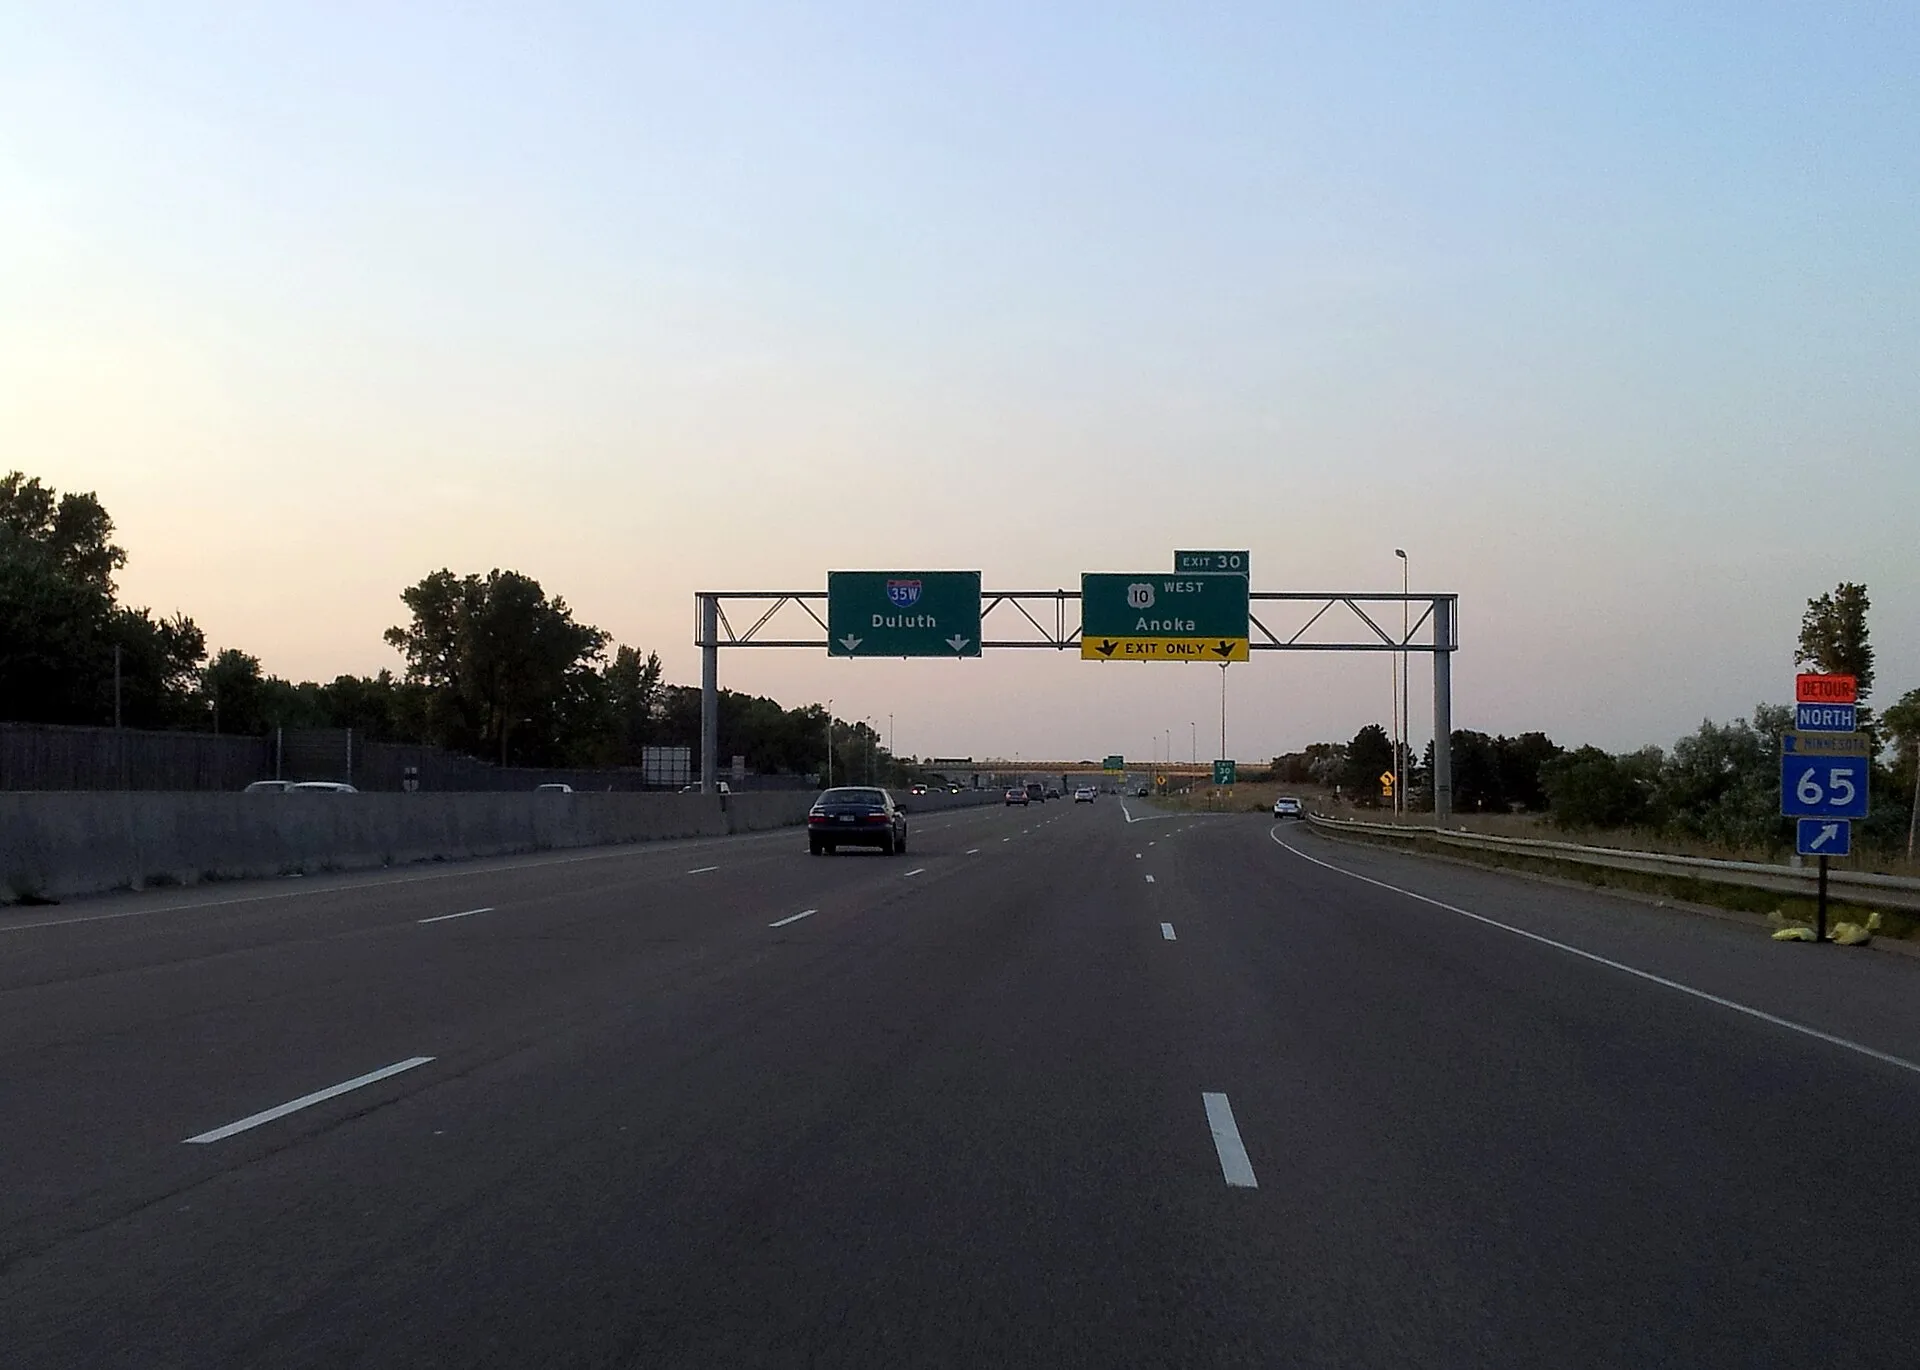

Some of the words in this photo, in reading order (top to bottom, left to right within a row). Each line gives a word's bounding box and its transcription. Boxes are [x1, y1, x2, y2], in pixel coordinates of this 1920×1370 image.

[1183, 557, 1210, 567] EXIT
[1217, 555, 1241, 568] 30
[891, 587, 918, 600] 35W
[1164, 582, 1204, 592] WEST
[1133, 590, 1149, 603] 10
[872, 614, 936, 628] Duluth
[1135, 617, 1196, 631] Anoka
[1125, 643, 1158, 654] EXIT
[1166, 643, 1205, 654] ONLY
[1802, 680, 1850, 697] DETOUR
[1800, 709, 1852, 726] NORTH
[1804, 738, 1865, 751] MINNESOTA
[1219, 767, 1231, 775] 30
[1797, 767, 1855, 806] 65
